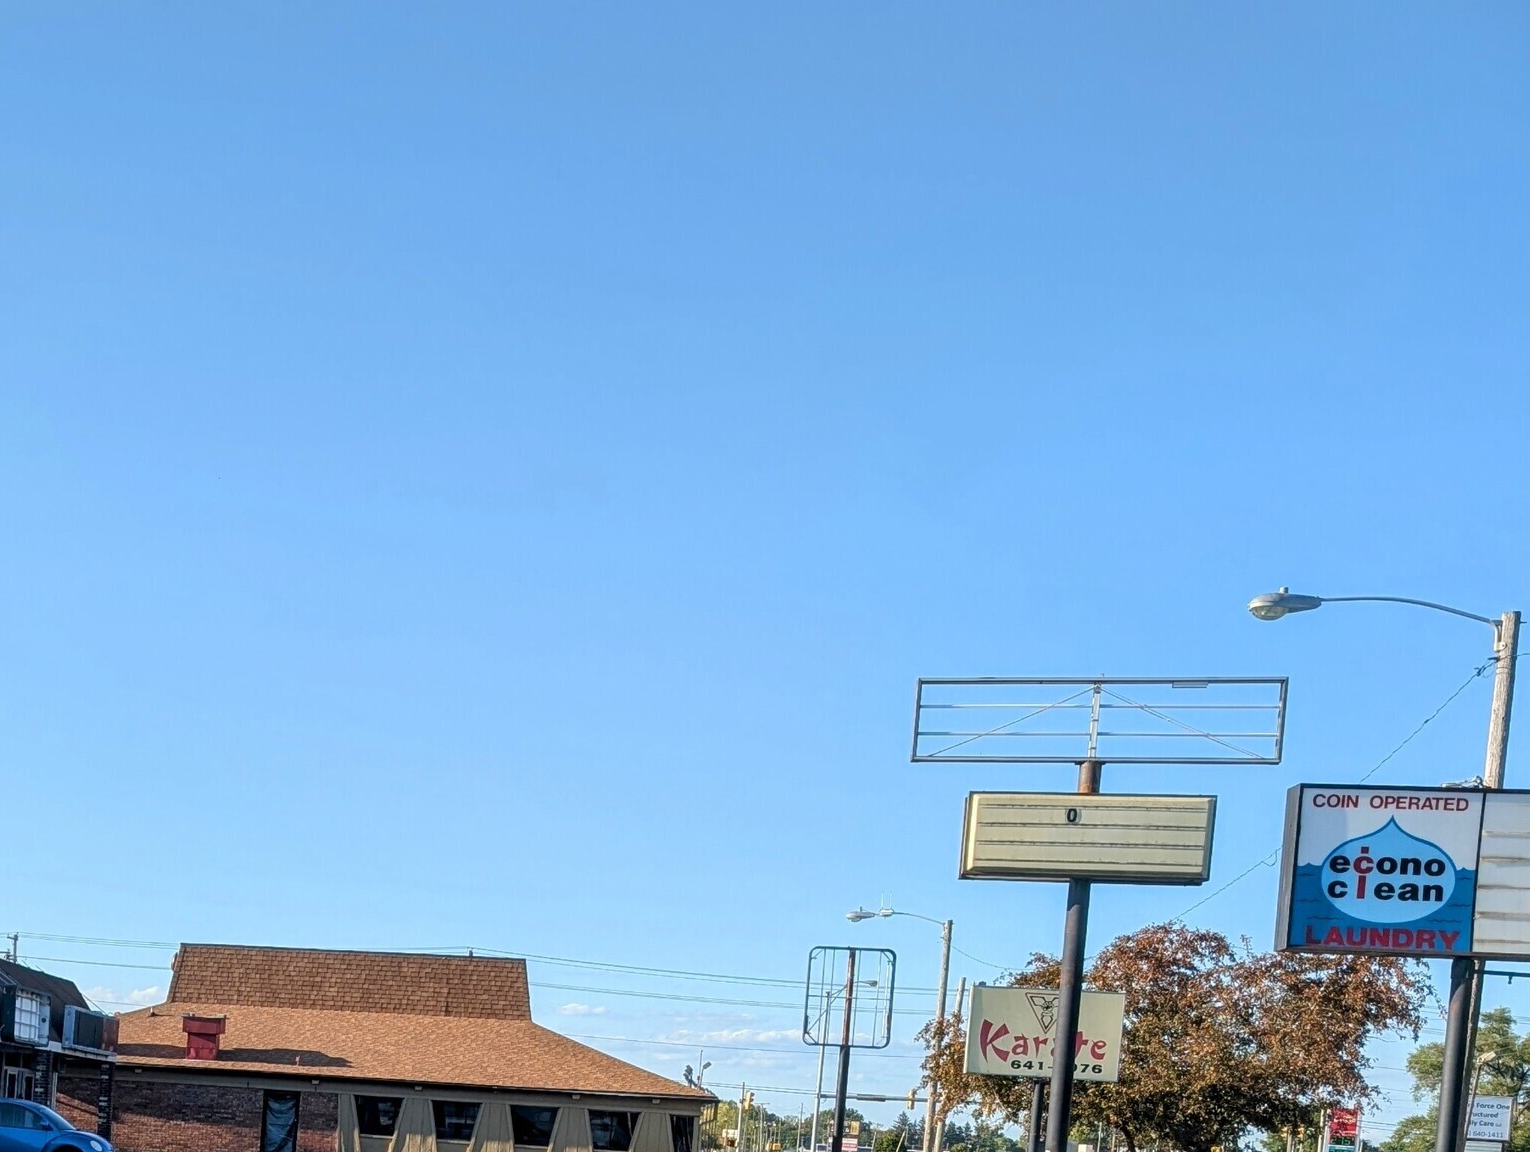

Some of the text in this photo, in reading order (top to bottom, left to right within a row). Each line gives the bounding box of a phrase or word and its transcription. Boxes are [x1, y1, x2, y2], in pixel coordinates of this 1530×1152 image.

[1312, 793, 1469, 812] COIN OPERATED
[1329, 854, 1446, 877] econo
[1327, 876, 1444, 902] clean
[1304, 925, 1461, 949] LAUNDRY
[979, 1018, 1108, 1063] Karte
[1010, 1059, 1103, 1074] 641-76
[1476, 1102, 1495, 1110] Force
